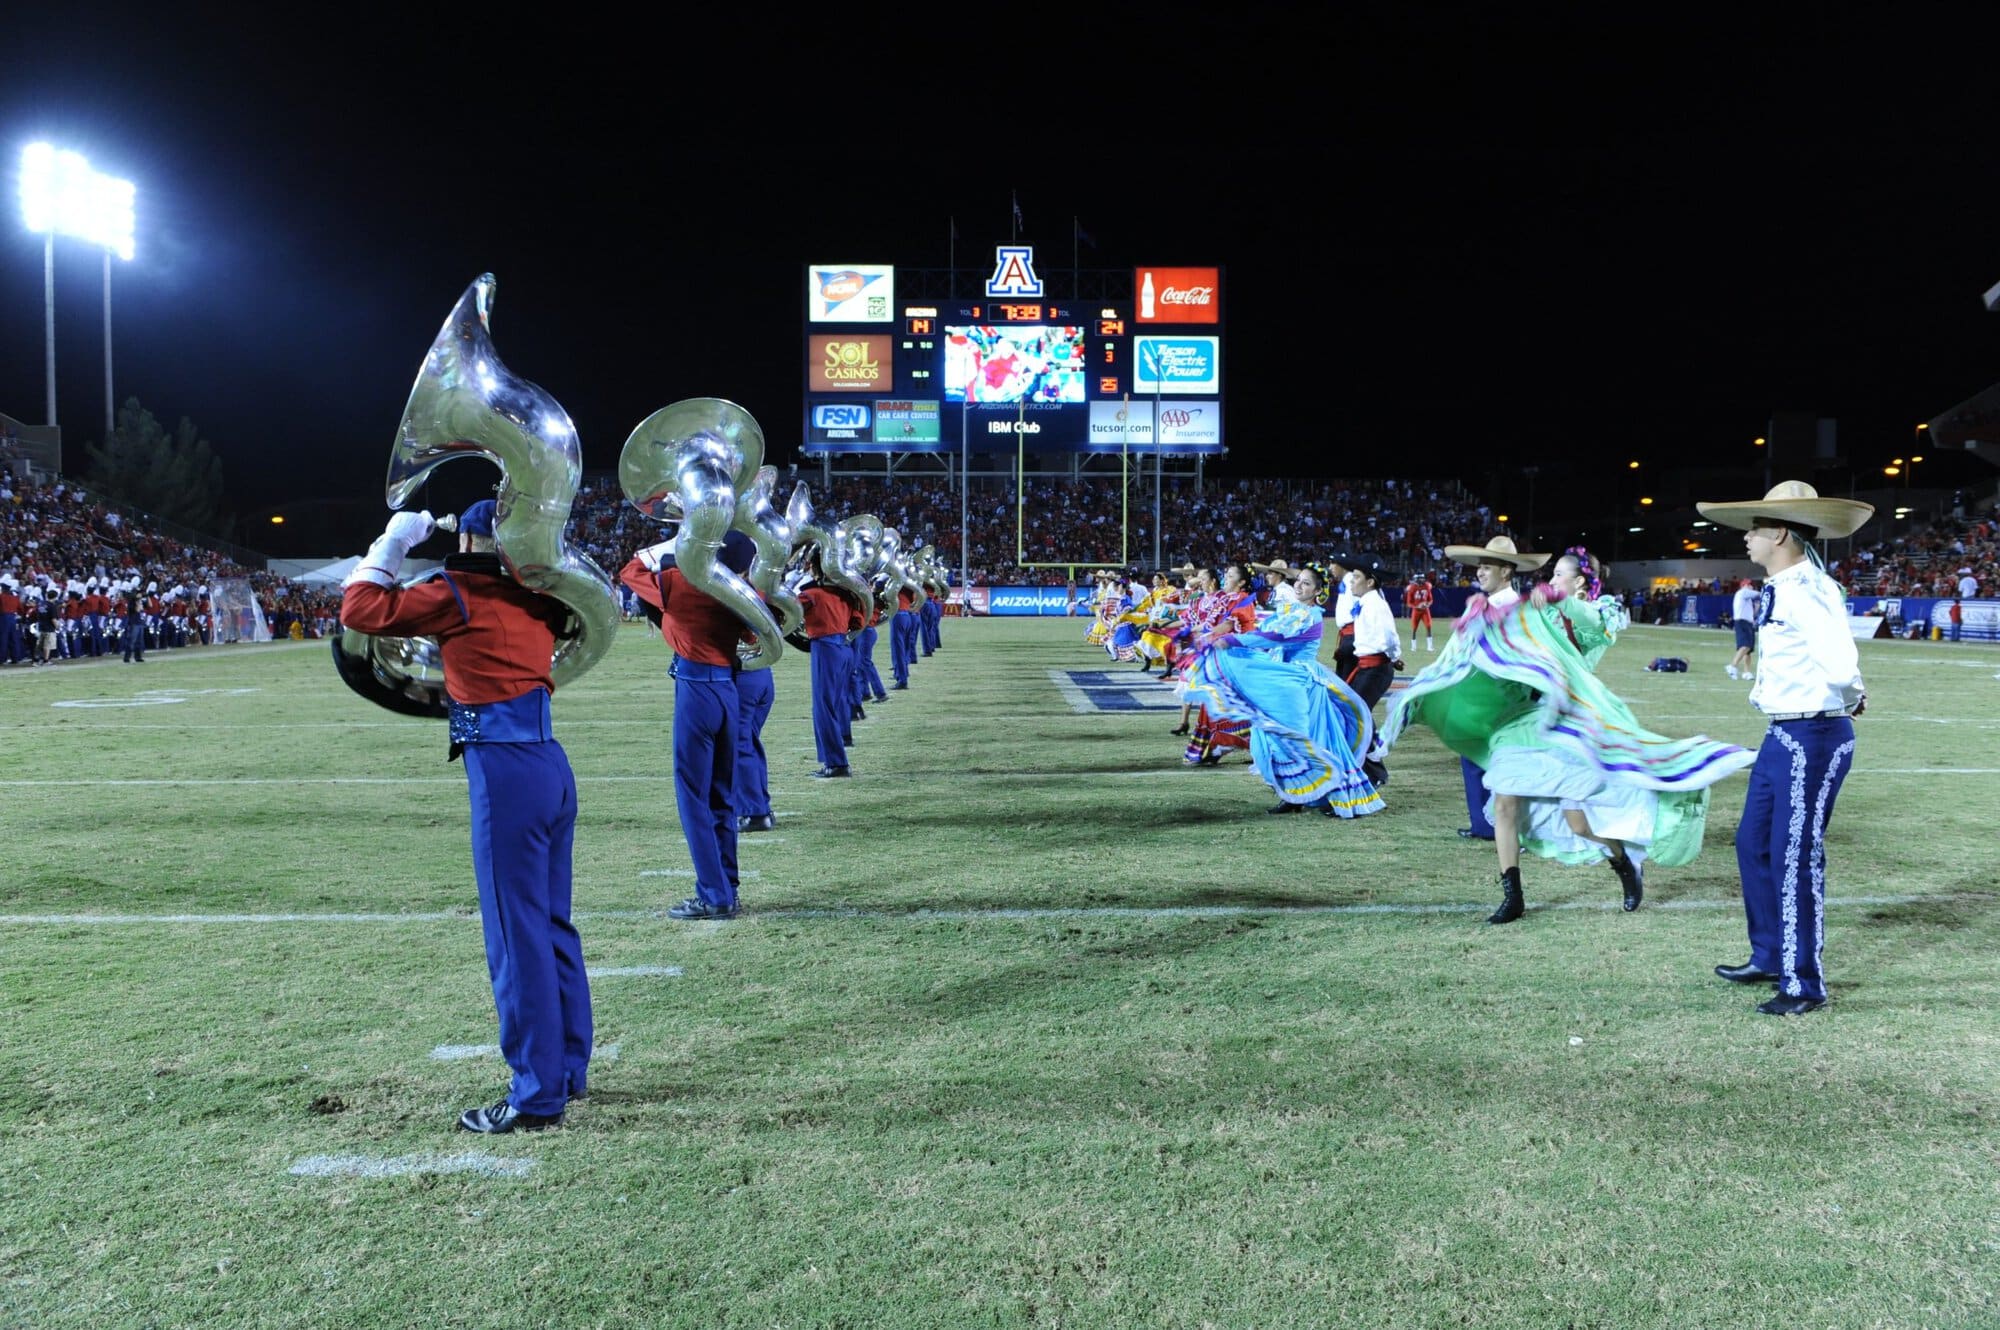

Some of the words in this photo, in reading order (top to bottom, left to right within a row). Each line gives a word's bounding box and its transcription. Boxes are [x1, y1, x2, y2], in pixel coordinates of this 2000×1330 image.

[985, 246, 1044, 297] A
[972, 306, 980, 318] 3
[1000, 304, 1041, 320] 7:39
[1050, 307, 1058, 318] 3
[1101, 320, 1124, 334] 24
[825, 342, 878, 367] SOL
[1158, 344, 1197, 356] Tucson
[1105, 351, 1114, 362] 3
[1161, 355, 1207, 366] Electric
[824, 368, 879, 379] CASINOS
[1166, 365, 1206, 376] Power
[821, 407, 861, 425] FSN
[1162, 409, 1190, 427] AAA
[988, 421, 1012, 433] IBM
[1013, 421, 1041, 433] Club
[1176, 429, 1215, 437] Insurance
